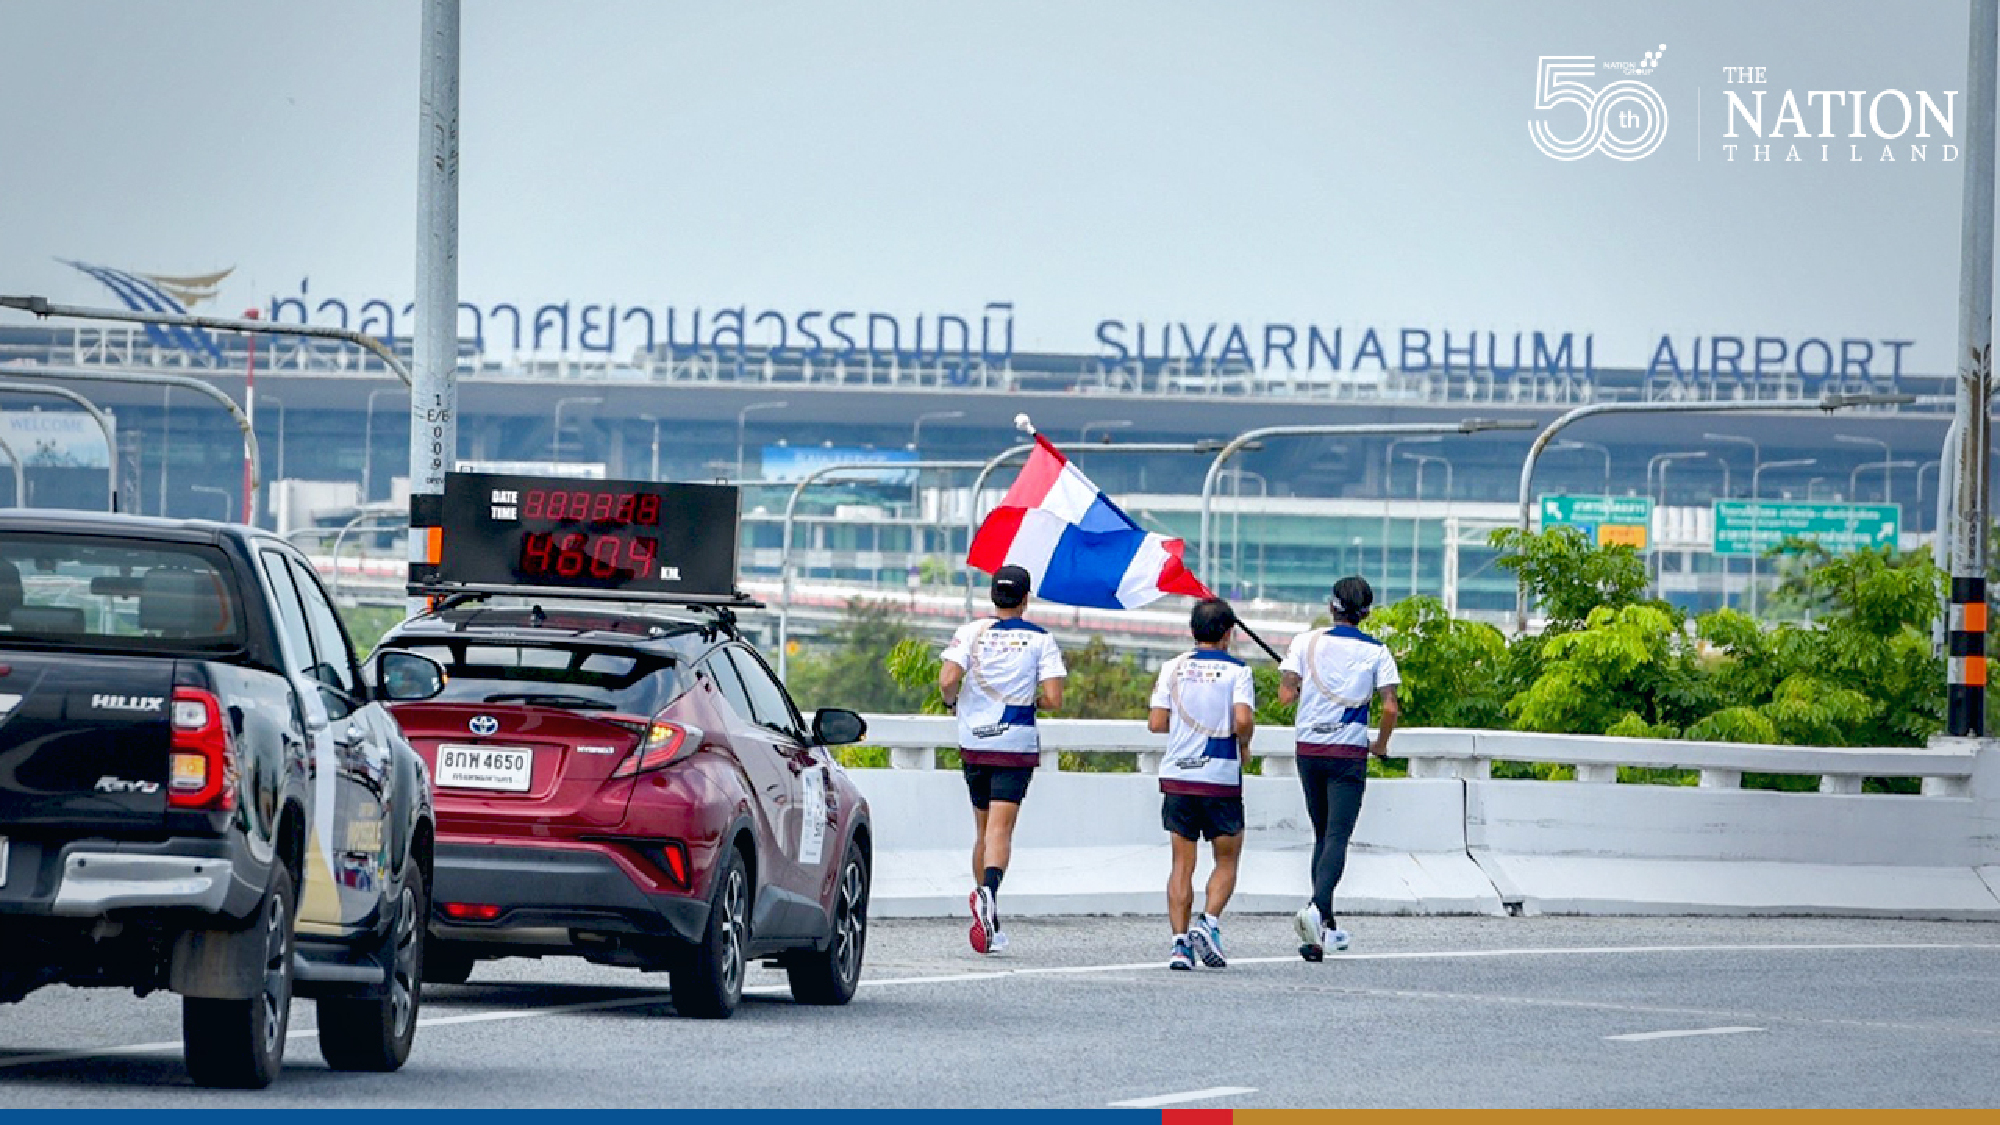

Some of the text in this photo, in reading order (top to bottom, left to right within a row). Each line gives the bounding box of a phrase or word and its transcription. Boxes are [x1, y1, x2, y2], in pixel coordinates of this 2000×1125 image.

[1096, 318, 1916, 384] SUVARNABHUMI AIRPORT
[491, 490, 518, 504] DATE
[491, 506, 518, 520] TIME
[91, 694, 164, 711] HILUX
[483, 753, 524, 772] 4650
